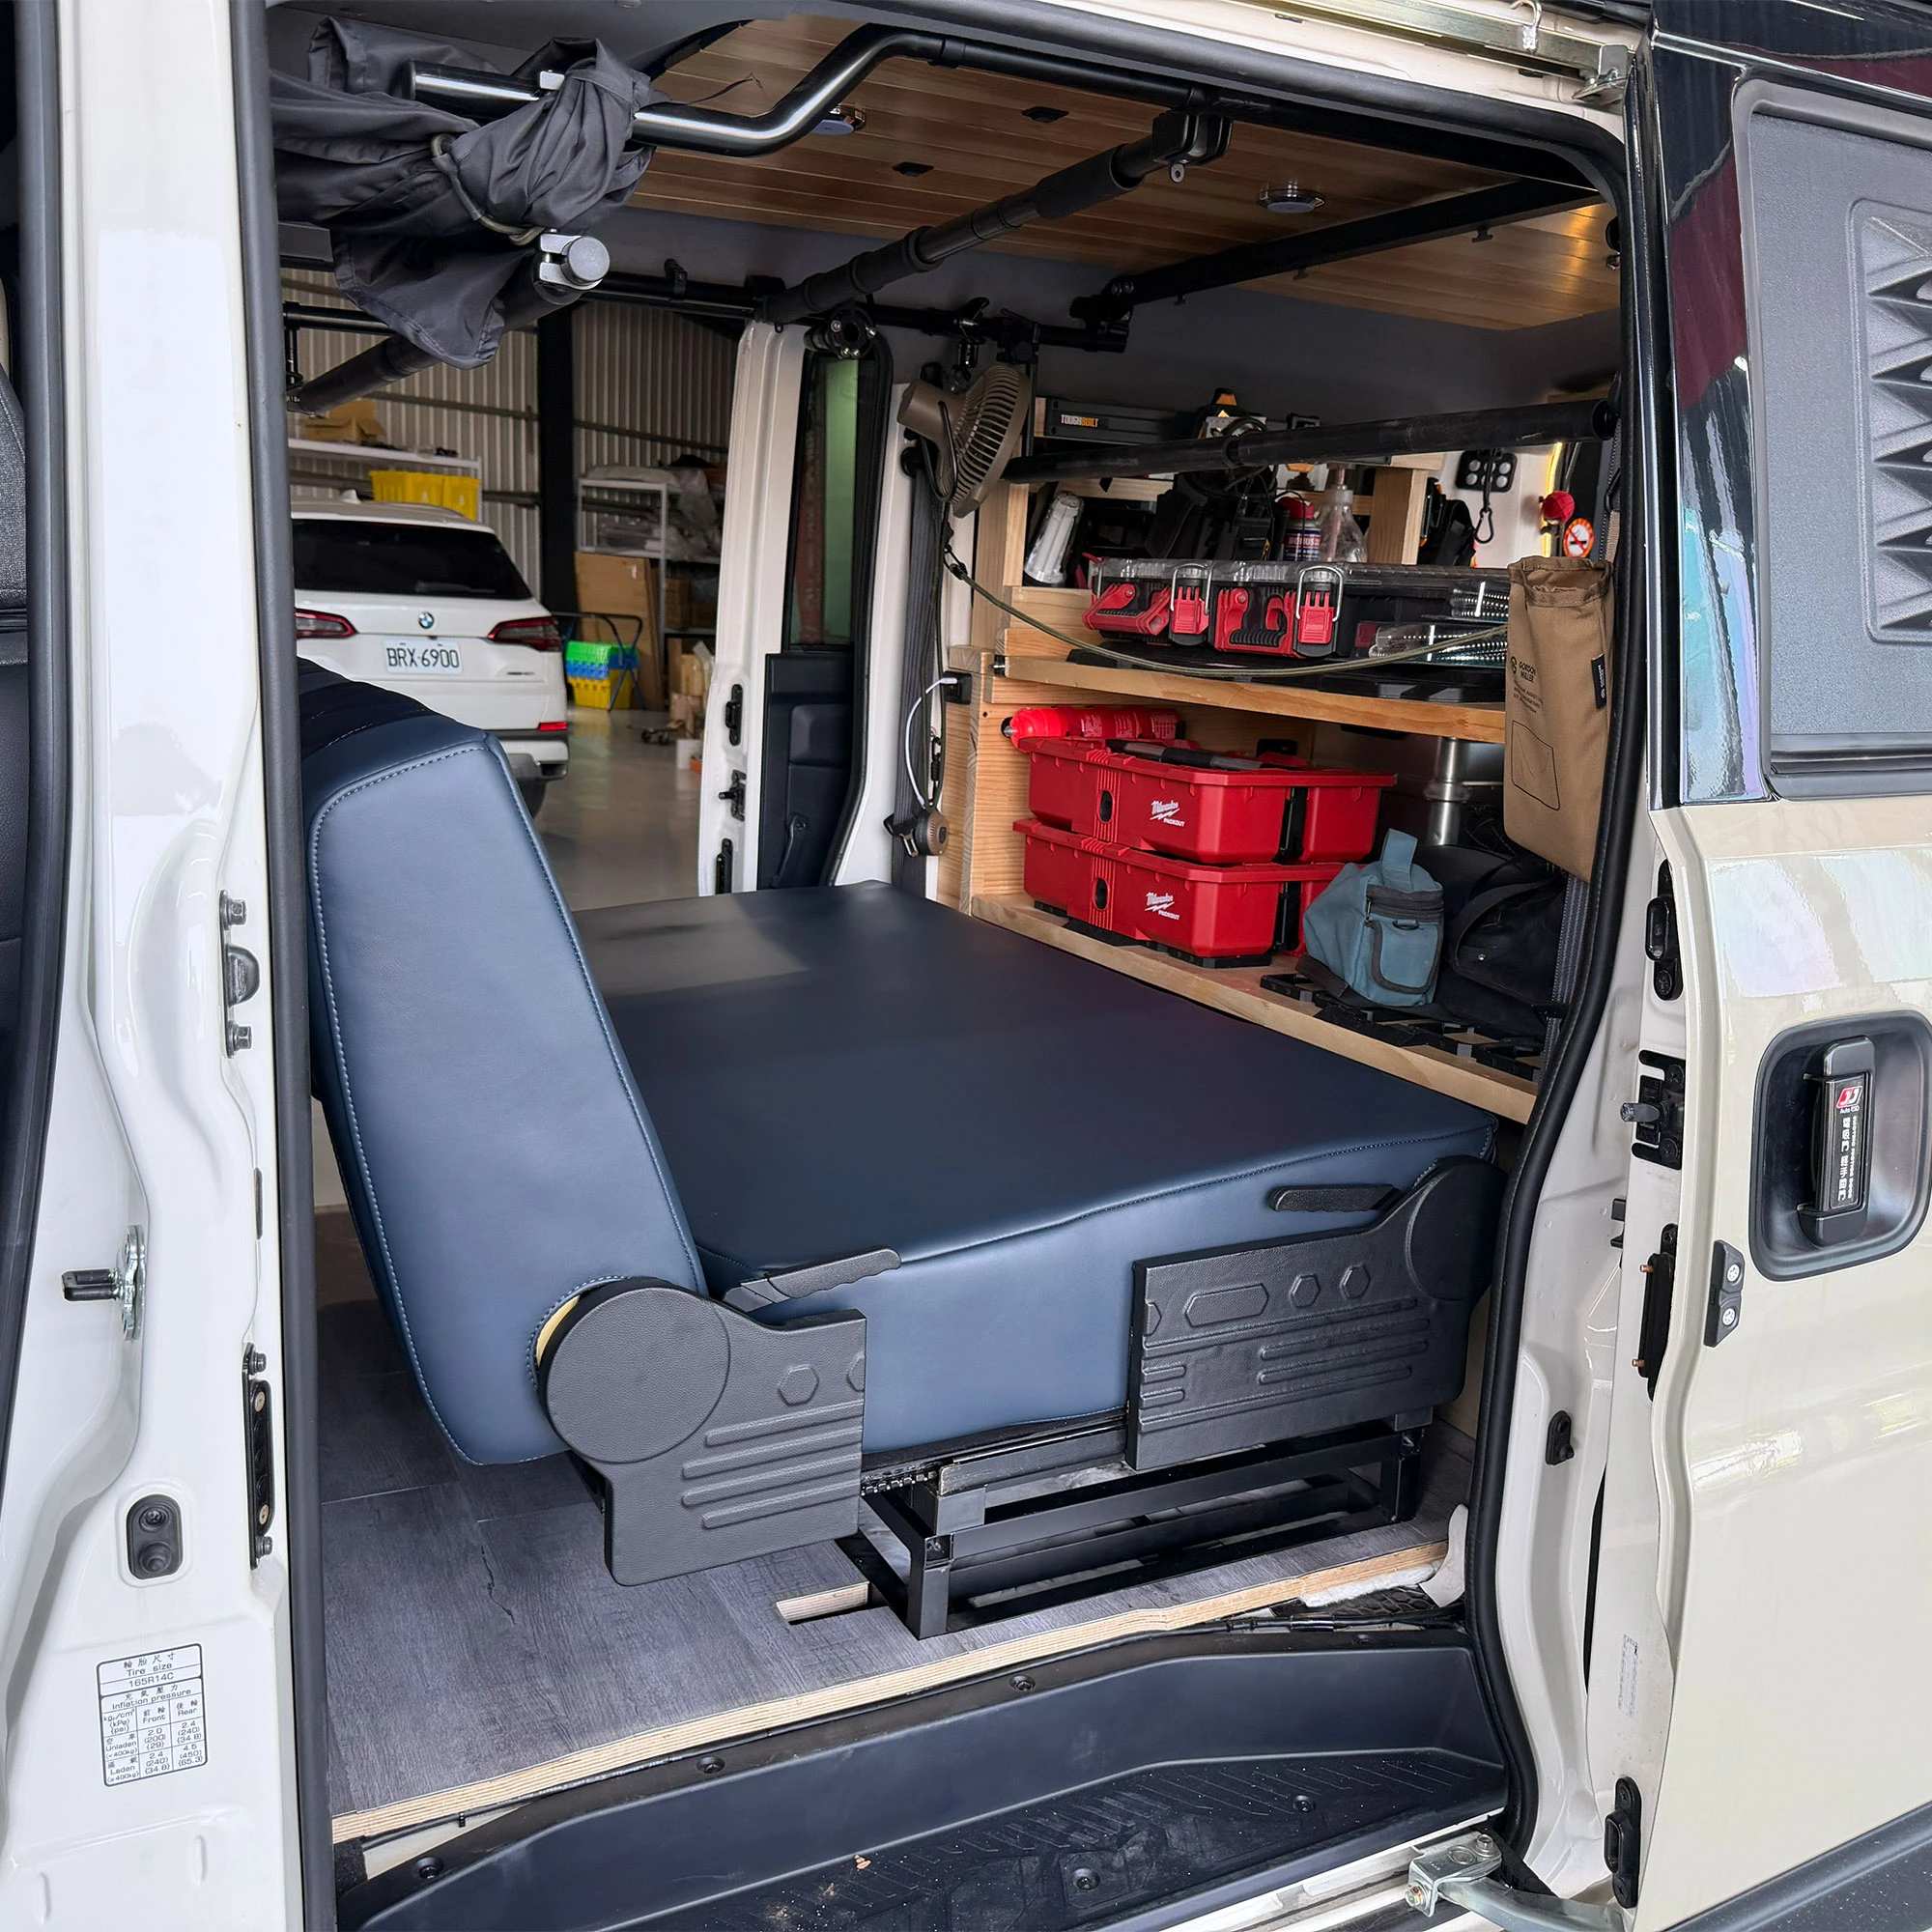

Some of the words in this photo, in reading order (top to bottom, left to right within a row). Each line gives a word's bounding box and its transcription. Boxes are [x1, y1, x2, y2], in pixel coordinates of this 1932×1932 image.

[1061, 414, 1099, 428] TOUGHBUILT
[385, 647, 460, 668] BRX-6900
[153, 1663, 173, 1672] size
[128, 1672, 174, 1688] 165R14C
[112, 1696, 149, 1710] Inflation
[151, 1689, 191, 1704] pressure
[178, 1708, 197, 1717] Rear
[109, 1719, 129, 1728] (kPa)
[143, 1715, 165, 1723] Front
[148, 1727, 162, 1736] 2.0
[177, 1726, 200, 1736] (240)
[106, 1741, 136, 1751] Unladen
[180, 1749, 202, 1759] (450)
[146, 1757, 169, 1767] (240)
[110, 1765, 135, 1775] Laden
